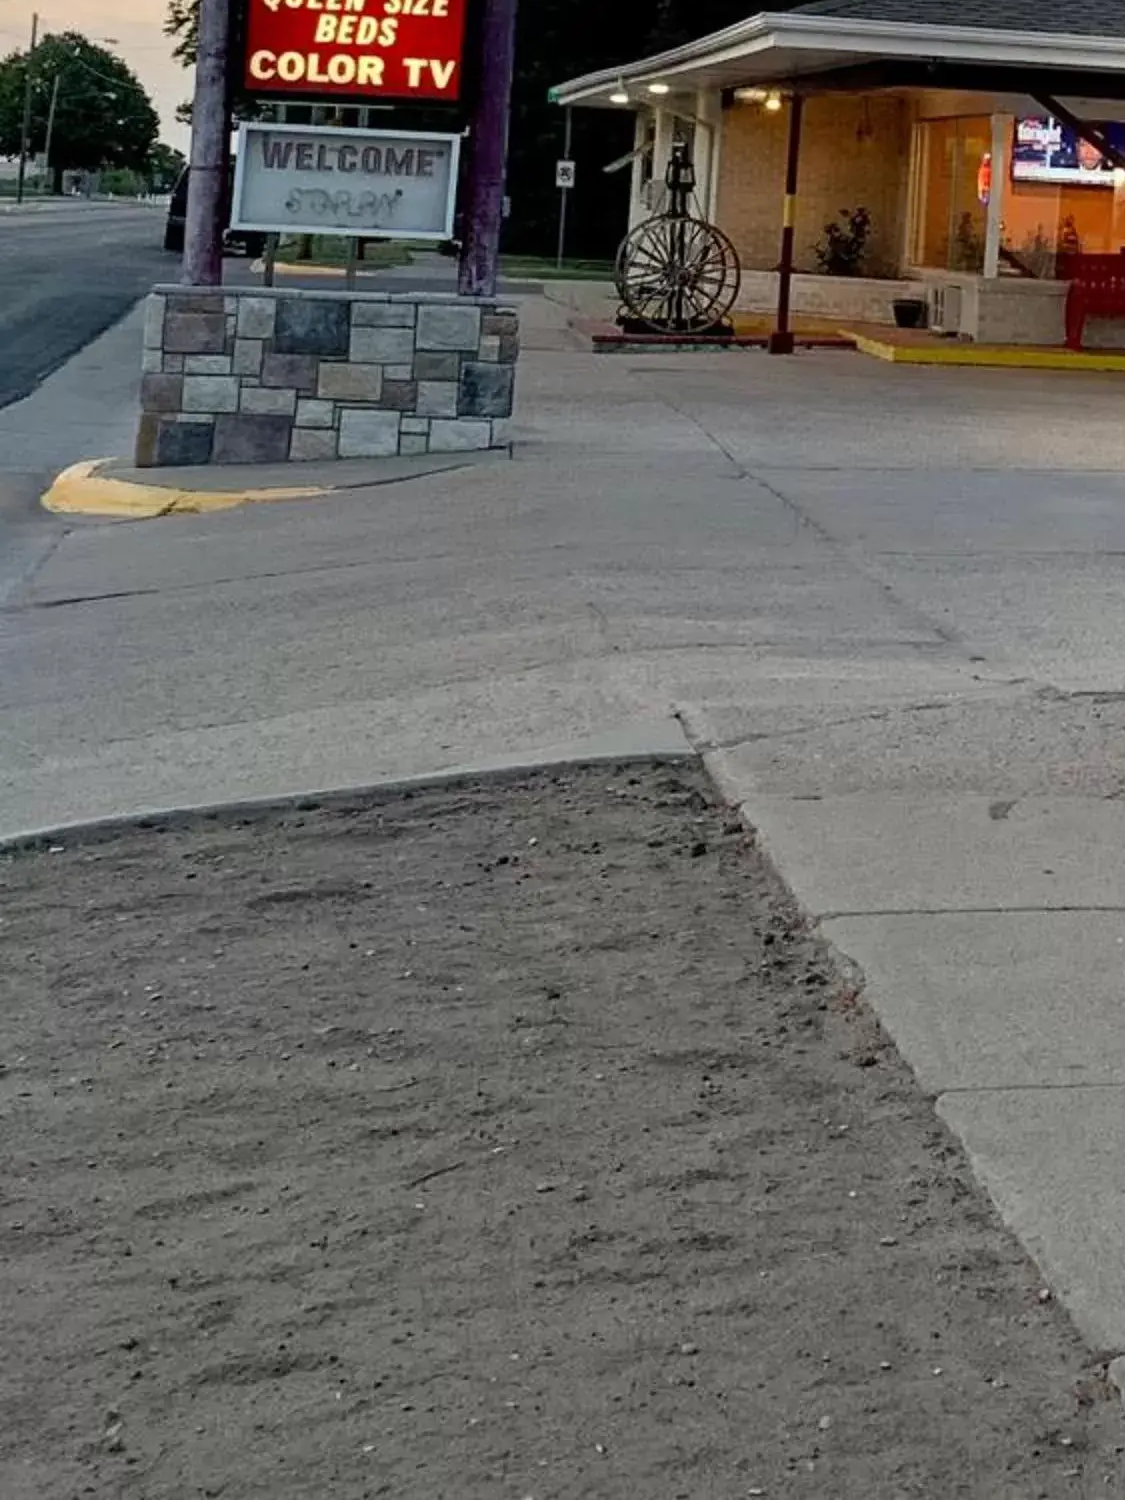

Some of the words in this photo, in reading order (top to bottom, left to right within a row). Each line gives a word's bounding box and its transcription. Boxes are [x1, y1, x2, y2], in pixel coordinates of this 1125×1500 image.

[314, 14, 399, 47] BEDS
[249, 50, 385, 85] COLOR
[402, 57, 456, 89] TV
[261, 139, 440, 177] WELCOME
